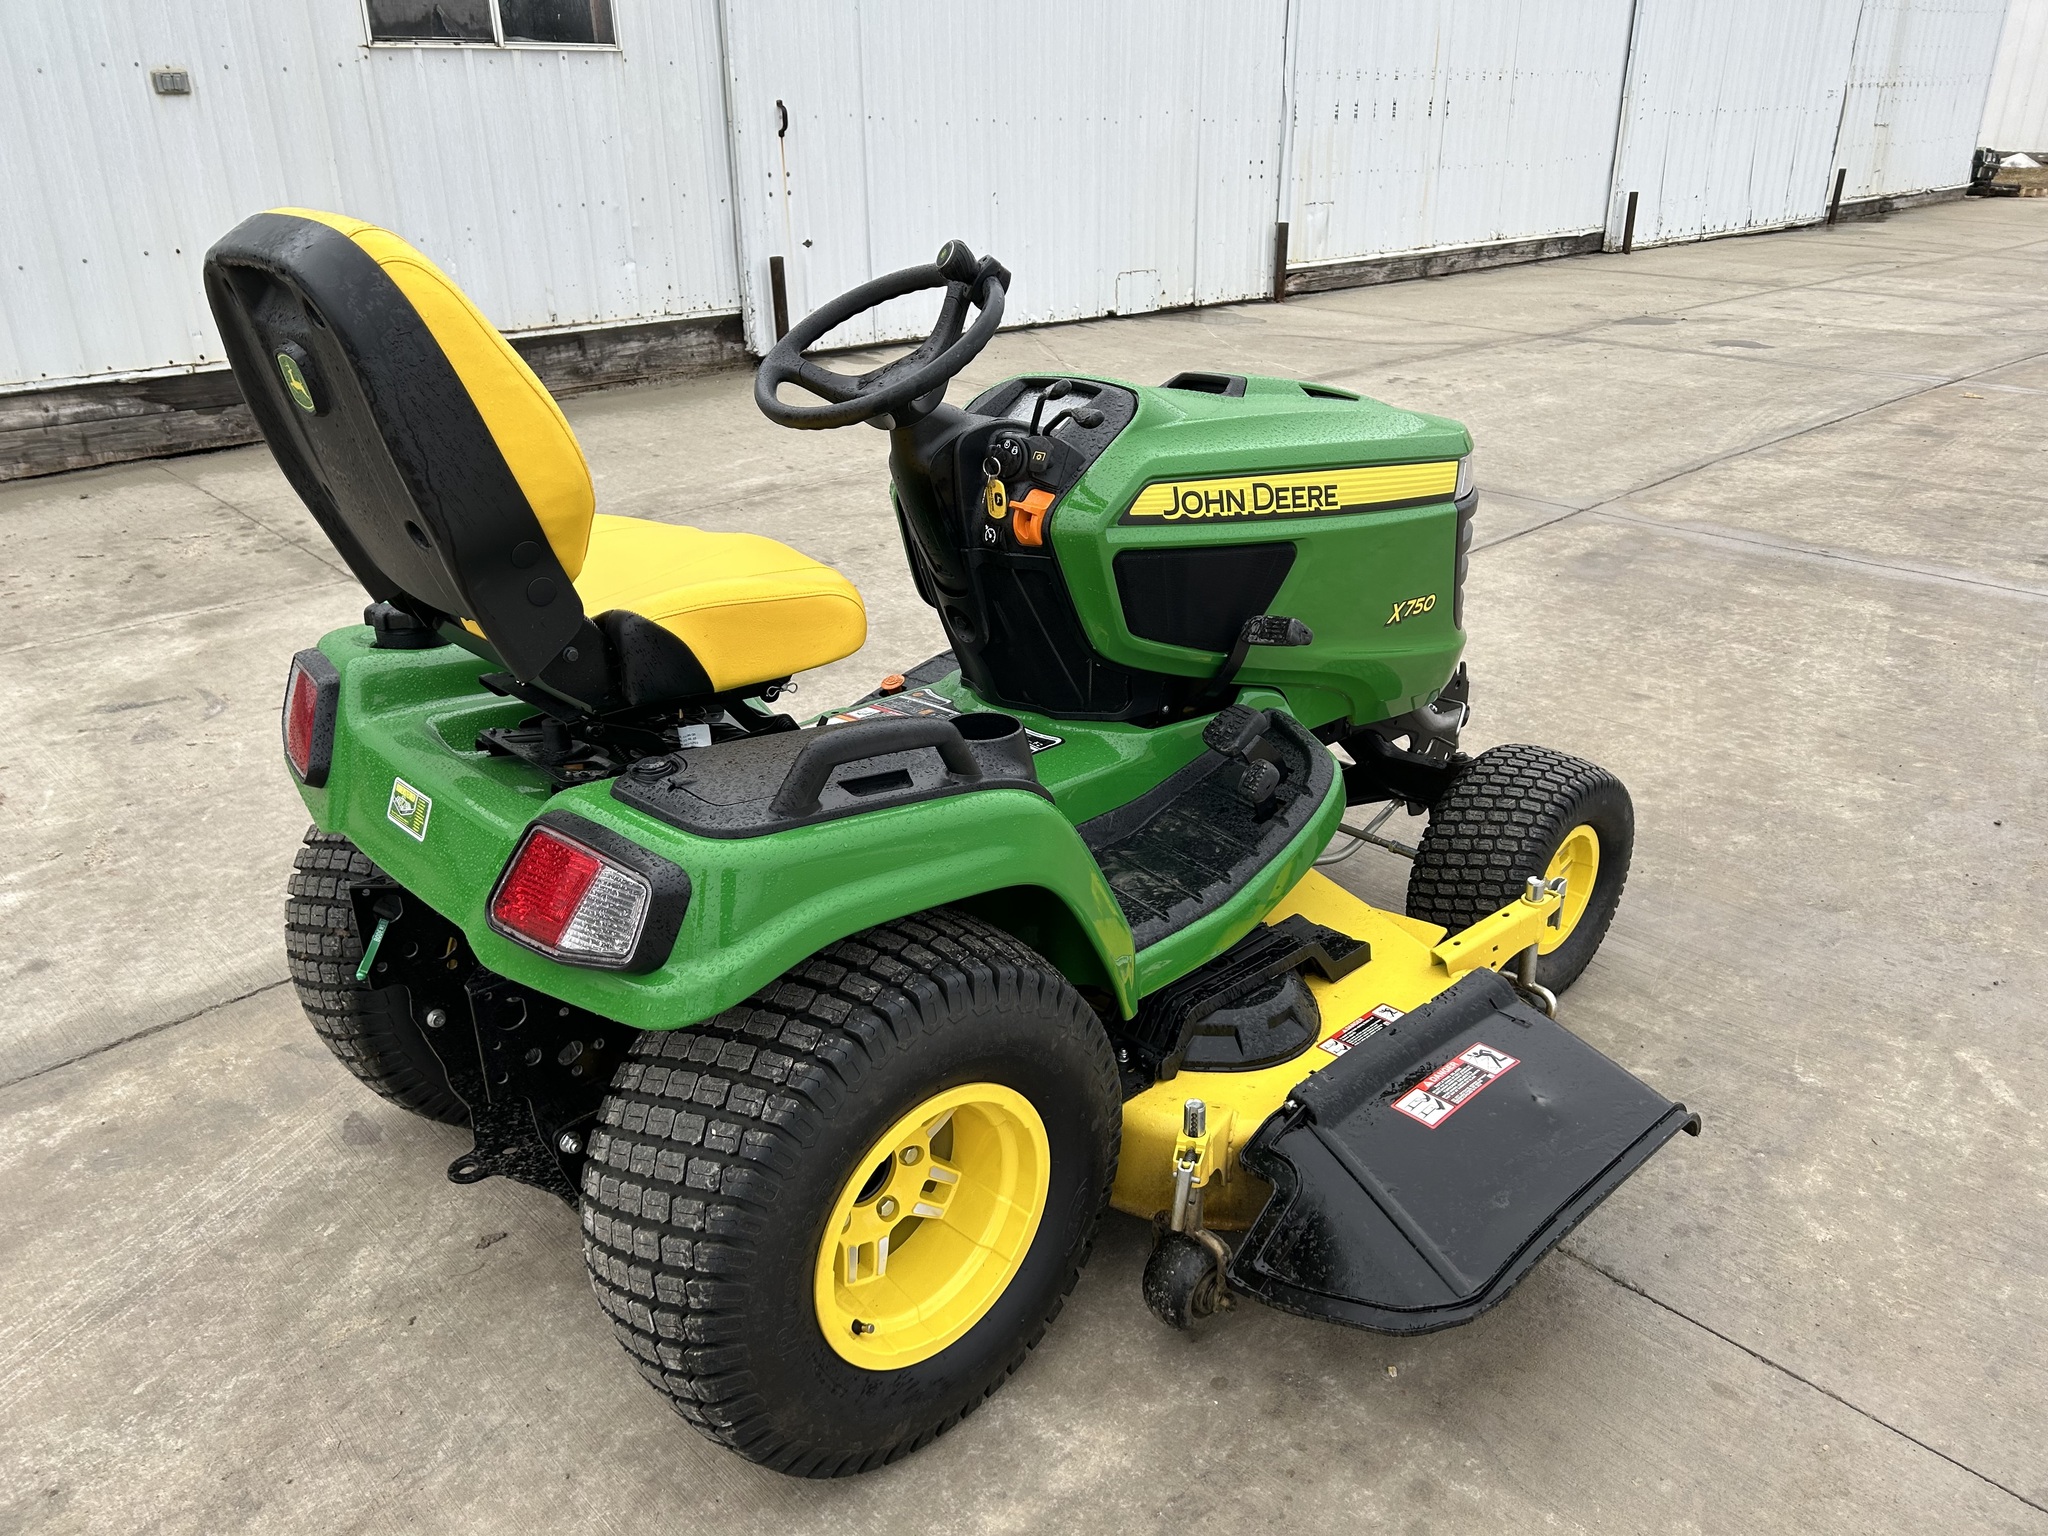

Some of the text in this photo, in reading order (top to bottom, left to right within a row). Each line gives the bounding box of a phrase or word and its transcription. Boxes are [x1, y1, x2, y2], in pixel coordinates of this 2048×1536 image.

[1163, 482, 1340, 517] JOHN DEERE
[1384, 593, 1437, 626] X750
[1429, 1060, 1460, 1083] DANGER
